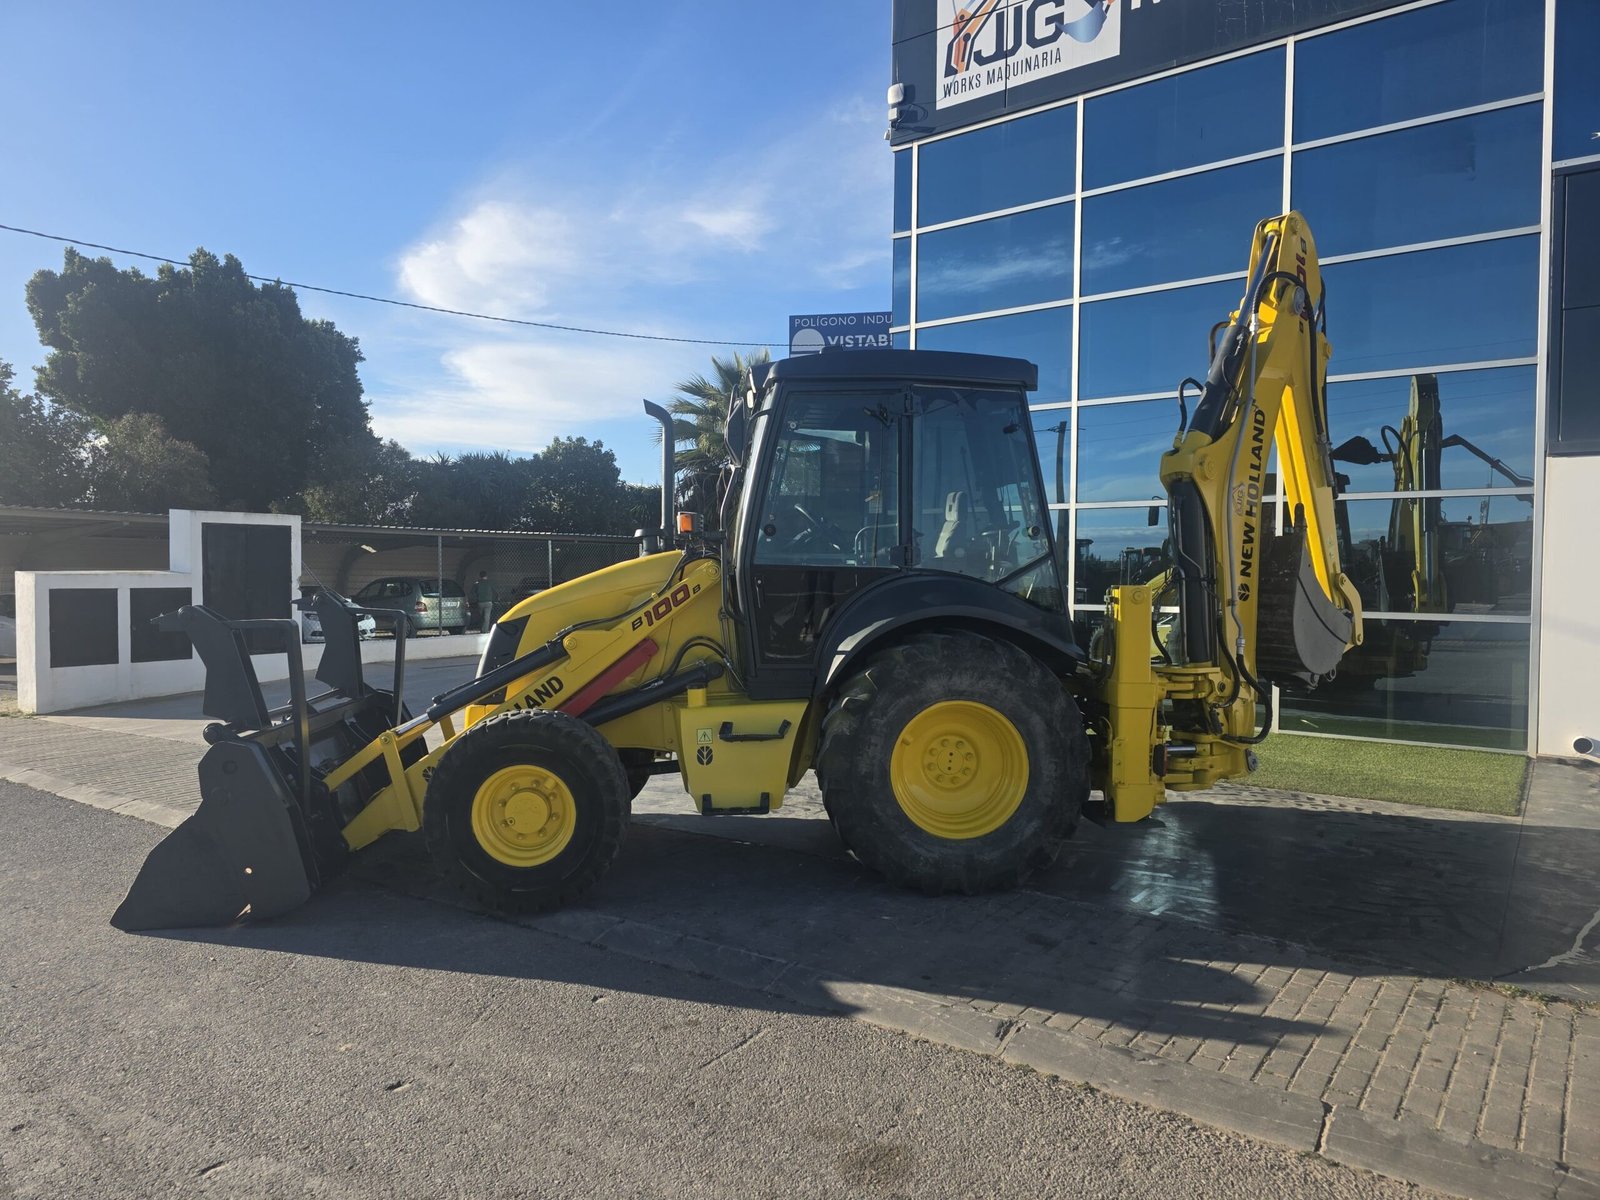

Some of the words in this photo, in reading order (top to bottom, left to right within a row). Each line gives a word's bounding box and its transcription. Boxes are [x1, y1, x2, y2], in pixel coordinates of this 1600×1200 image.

[943, 73, 982, 98] WORKS
[986, 47, 1062, 85] MAQUINARIA
[794, 316, 857, 328] POLÍGONO
[1245, 409, 1266, 519] HOLLAND
[1240, 522, 1255, 578] NEW
